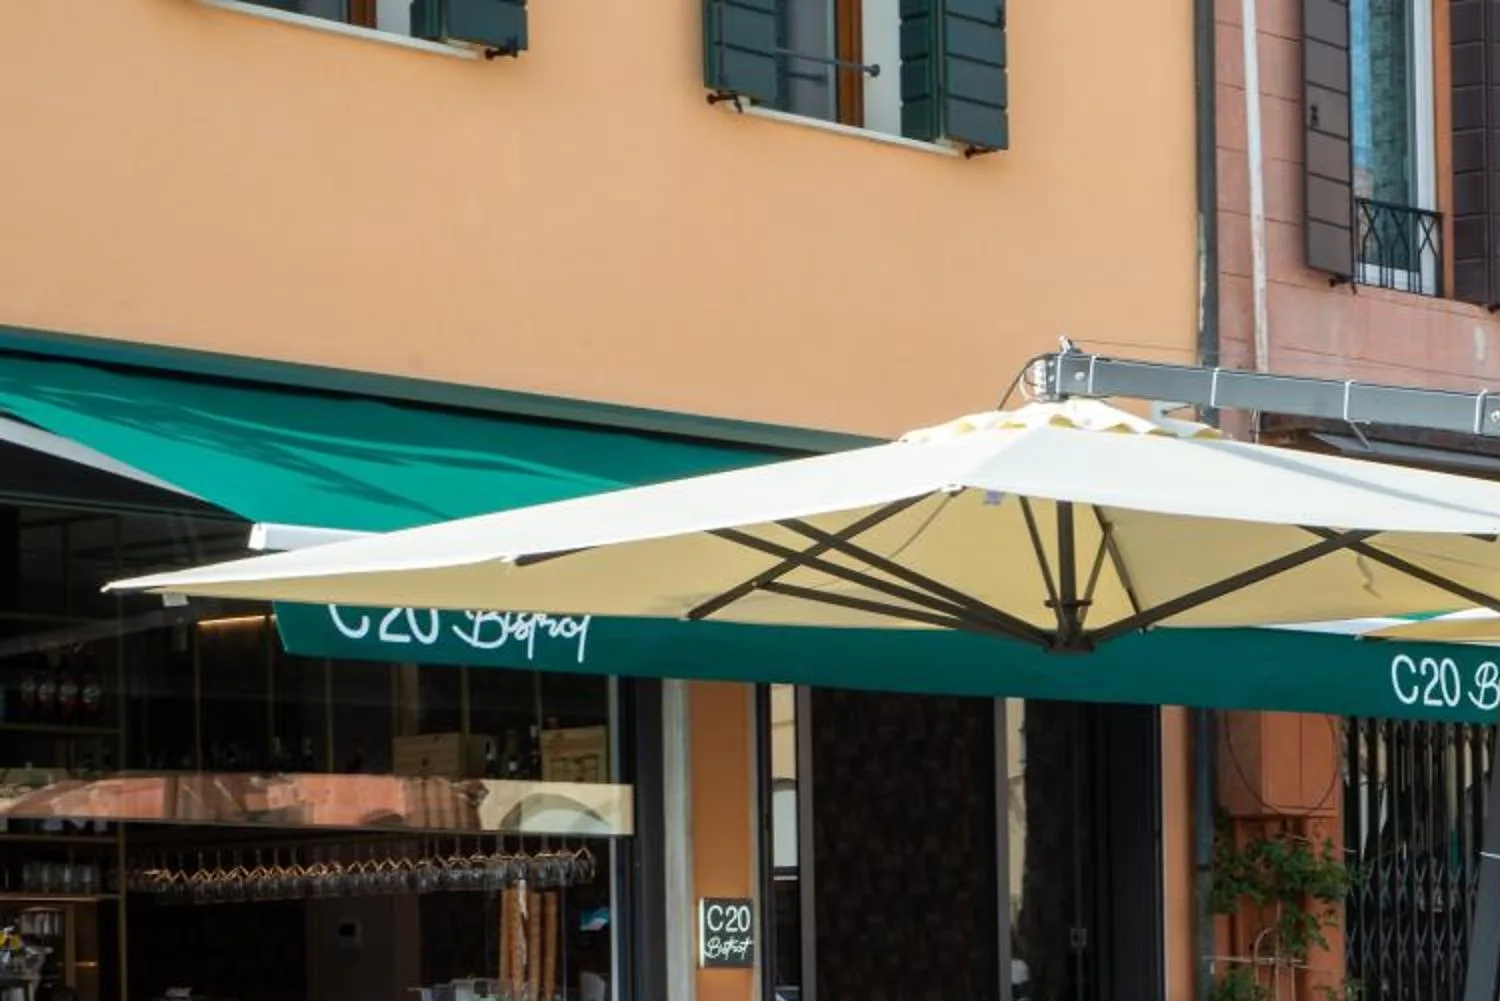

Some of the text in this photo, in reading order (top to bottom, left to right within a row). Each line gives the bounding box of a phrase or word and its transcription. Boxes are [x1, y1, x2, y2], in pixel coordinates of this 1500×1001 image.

[1391, 653, 1461, 708] C20
[707, 904, 751, 932] C20
[704, 936, 755, 961] Bistrot
